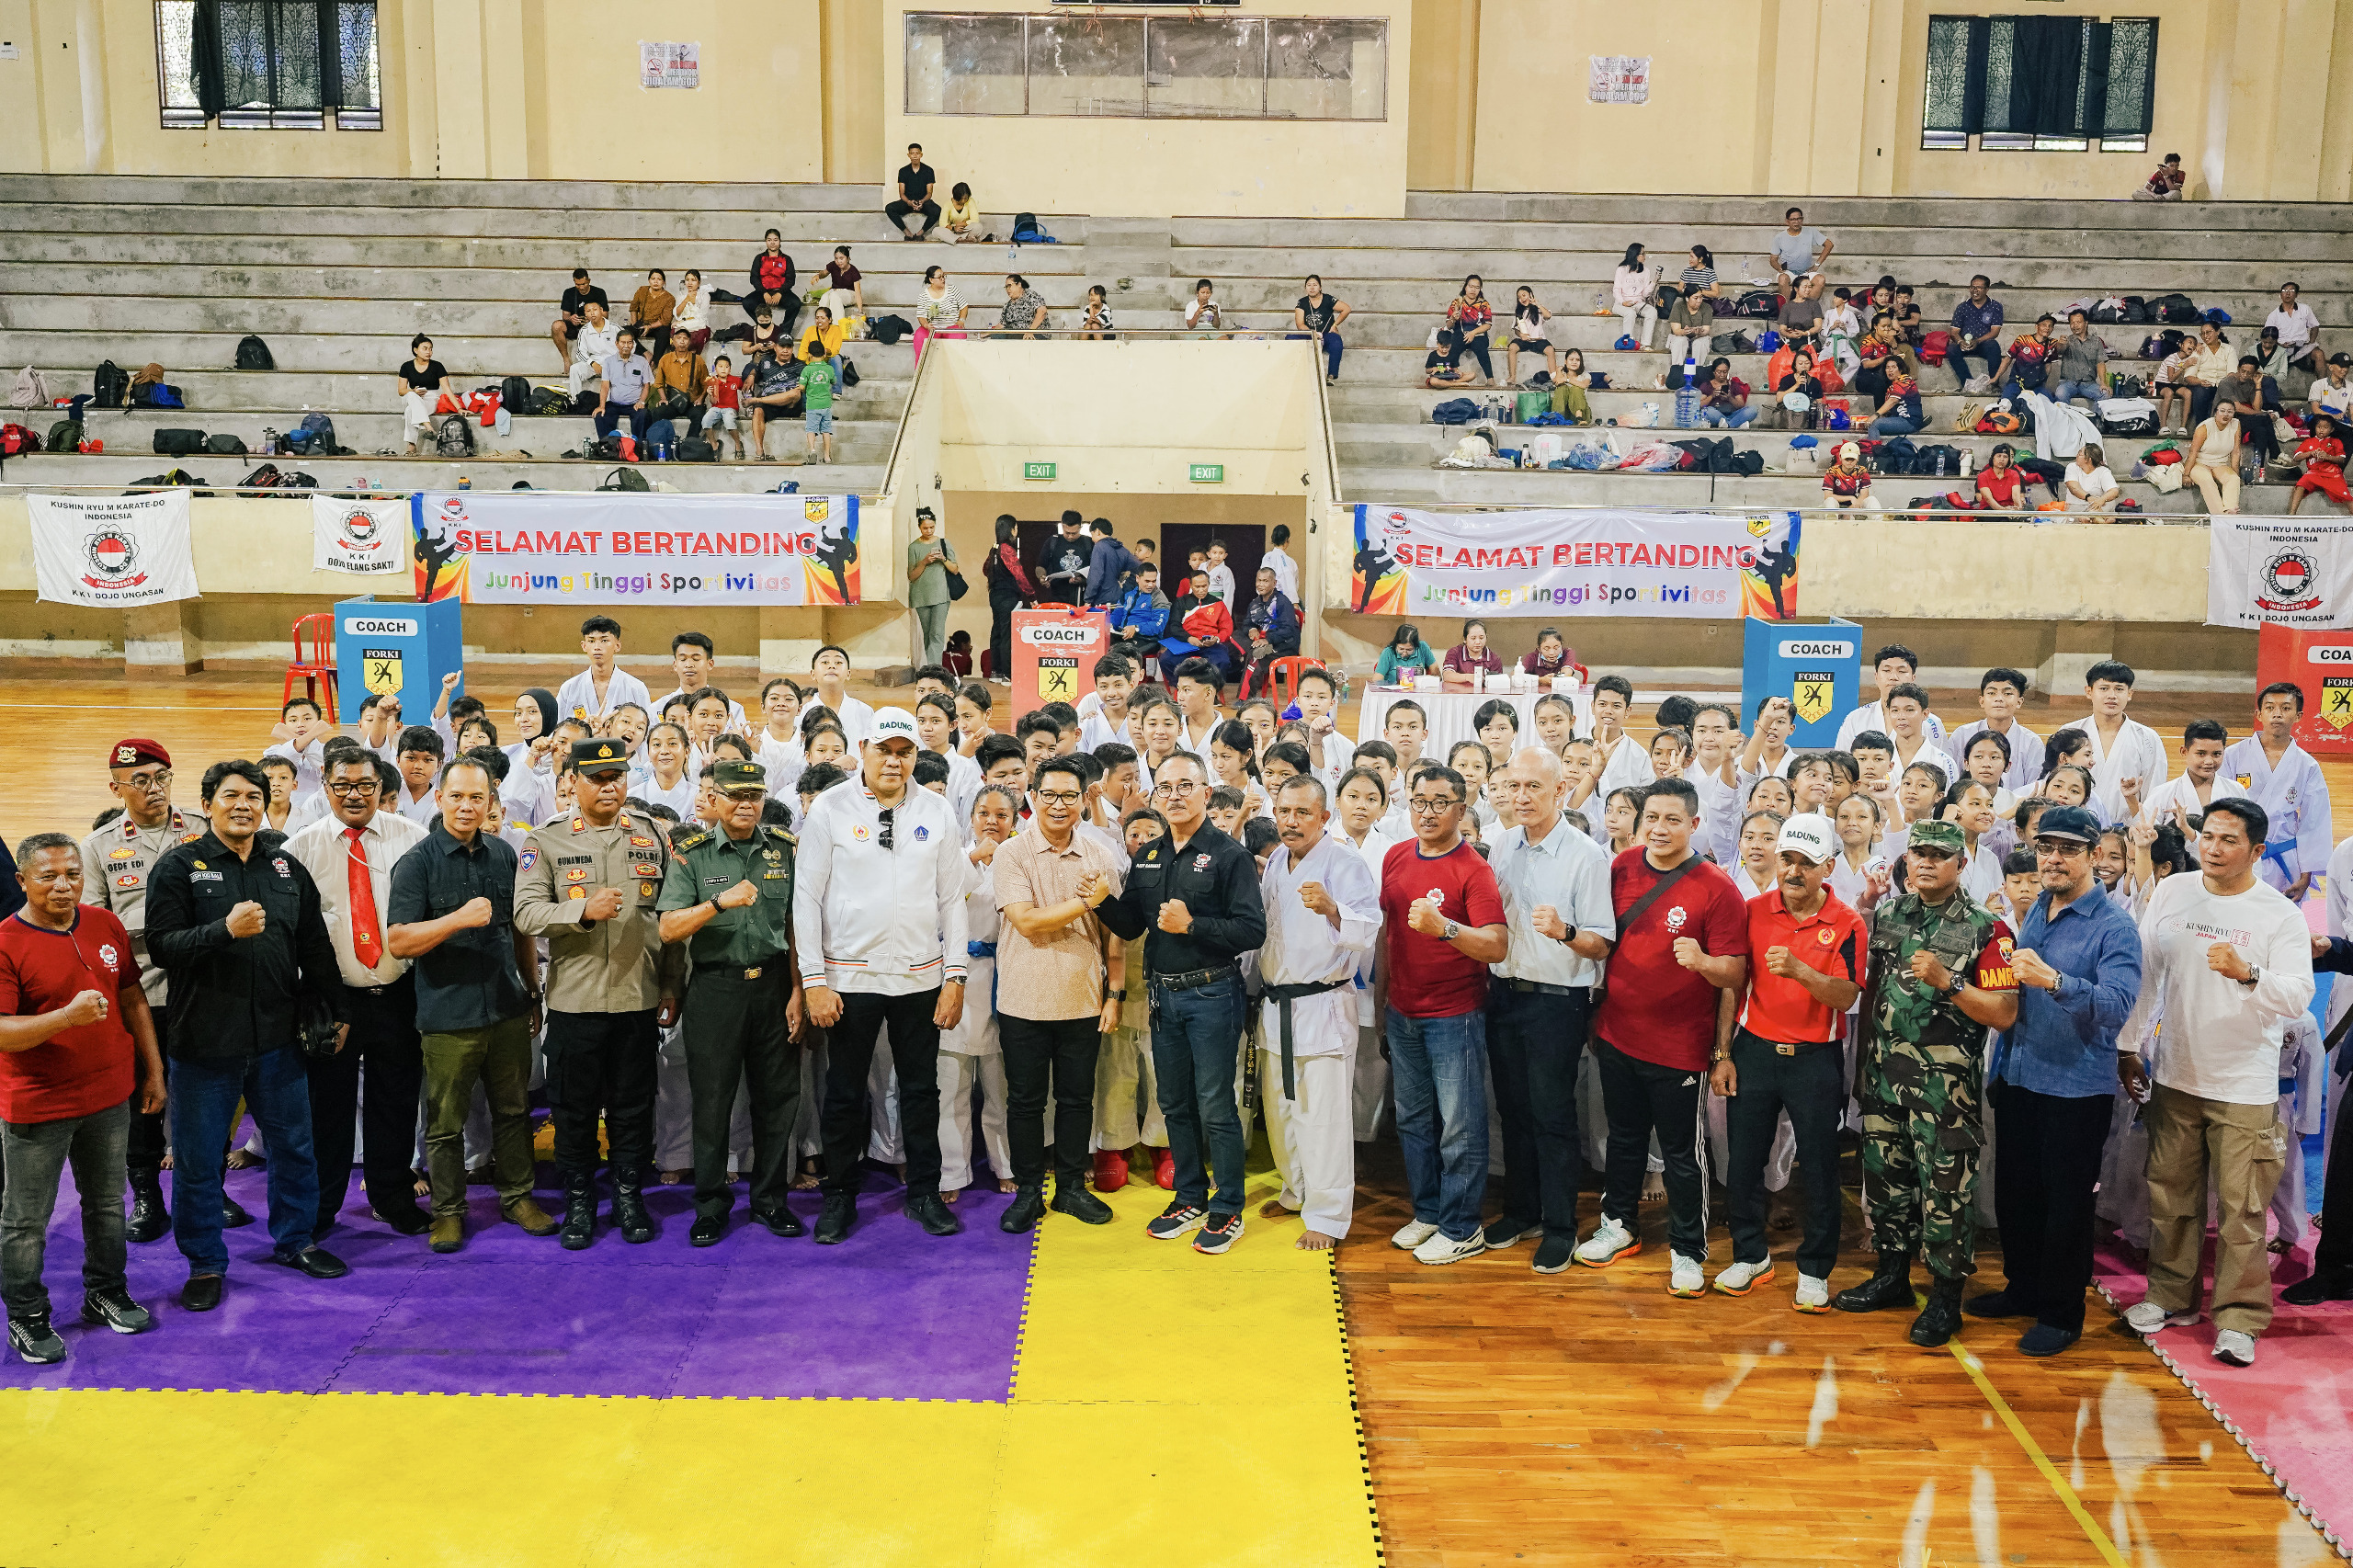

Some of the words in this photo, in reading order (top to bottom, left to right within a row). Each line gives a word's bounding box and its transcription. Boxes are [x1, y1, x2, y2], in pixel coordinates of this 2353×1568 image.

[1029, 464, 1051, 477] EXIT
[1196, 467, 1217, 479] EXIT
[51, 500, 84, 510] KUSHIN
[117, 499, 165, 511] KARATE-DO
[2235, 524, 2270, 532] KUSHIN
[454, 529, 603, 554] SELAMAT
[612, 531, 818, 556] BERTANDING
[1395, 542, 1544, 568] SELAMAT
[1552, 541, 1757, 569] BERTANDING
[347, 562, 369, 571] ELANG
[371, 561, 393, 571] SAKTI
[96, 578, 135, 588] INDONESIA
[484, 571, 574, 594] Junjung
[581, 572, 652, 594] Tinggi
[660, 572, 791, 594] Sportivitas
[122, 587, 164, 598] UNGASAN
[1422, 585, 1512, 606] Junjung
[1519, 585, 1590, 605] Tinggi
[1597, 583, 1727, 605] Sportivitas
[2268, 601, 2308, 610] INDONESIA
[2291, 614, 2335, 622] UNGASAN
[356, 621, 406, 632] COACH
[1033, 630, 1085, 641] COACH
[366, 650, 399, 659] FORKI
[1790, 643, 1842, 655] COACH
[2320, 649, 2352, 660] COA
[1041, 659, 1075, 667] FORKI
[1798, 673, 1832, 681] FORKI
[880, 722, 913, 732] BADUNG
[1786, 830, 1821, 845] BADUNG
[628, 851, 658, 861] POLRI
[108, 861, 128, 872] GEDE
[131, 859, 144, 869] EDI
[2186, 922, 2215, 934] KUSHIN
[2214, 926, 2231, 937] RYU
[2195, 932, 2217, 940] JAPAN
